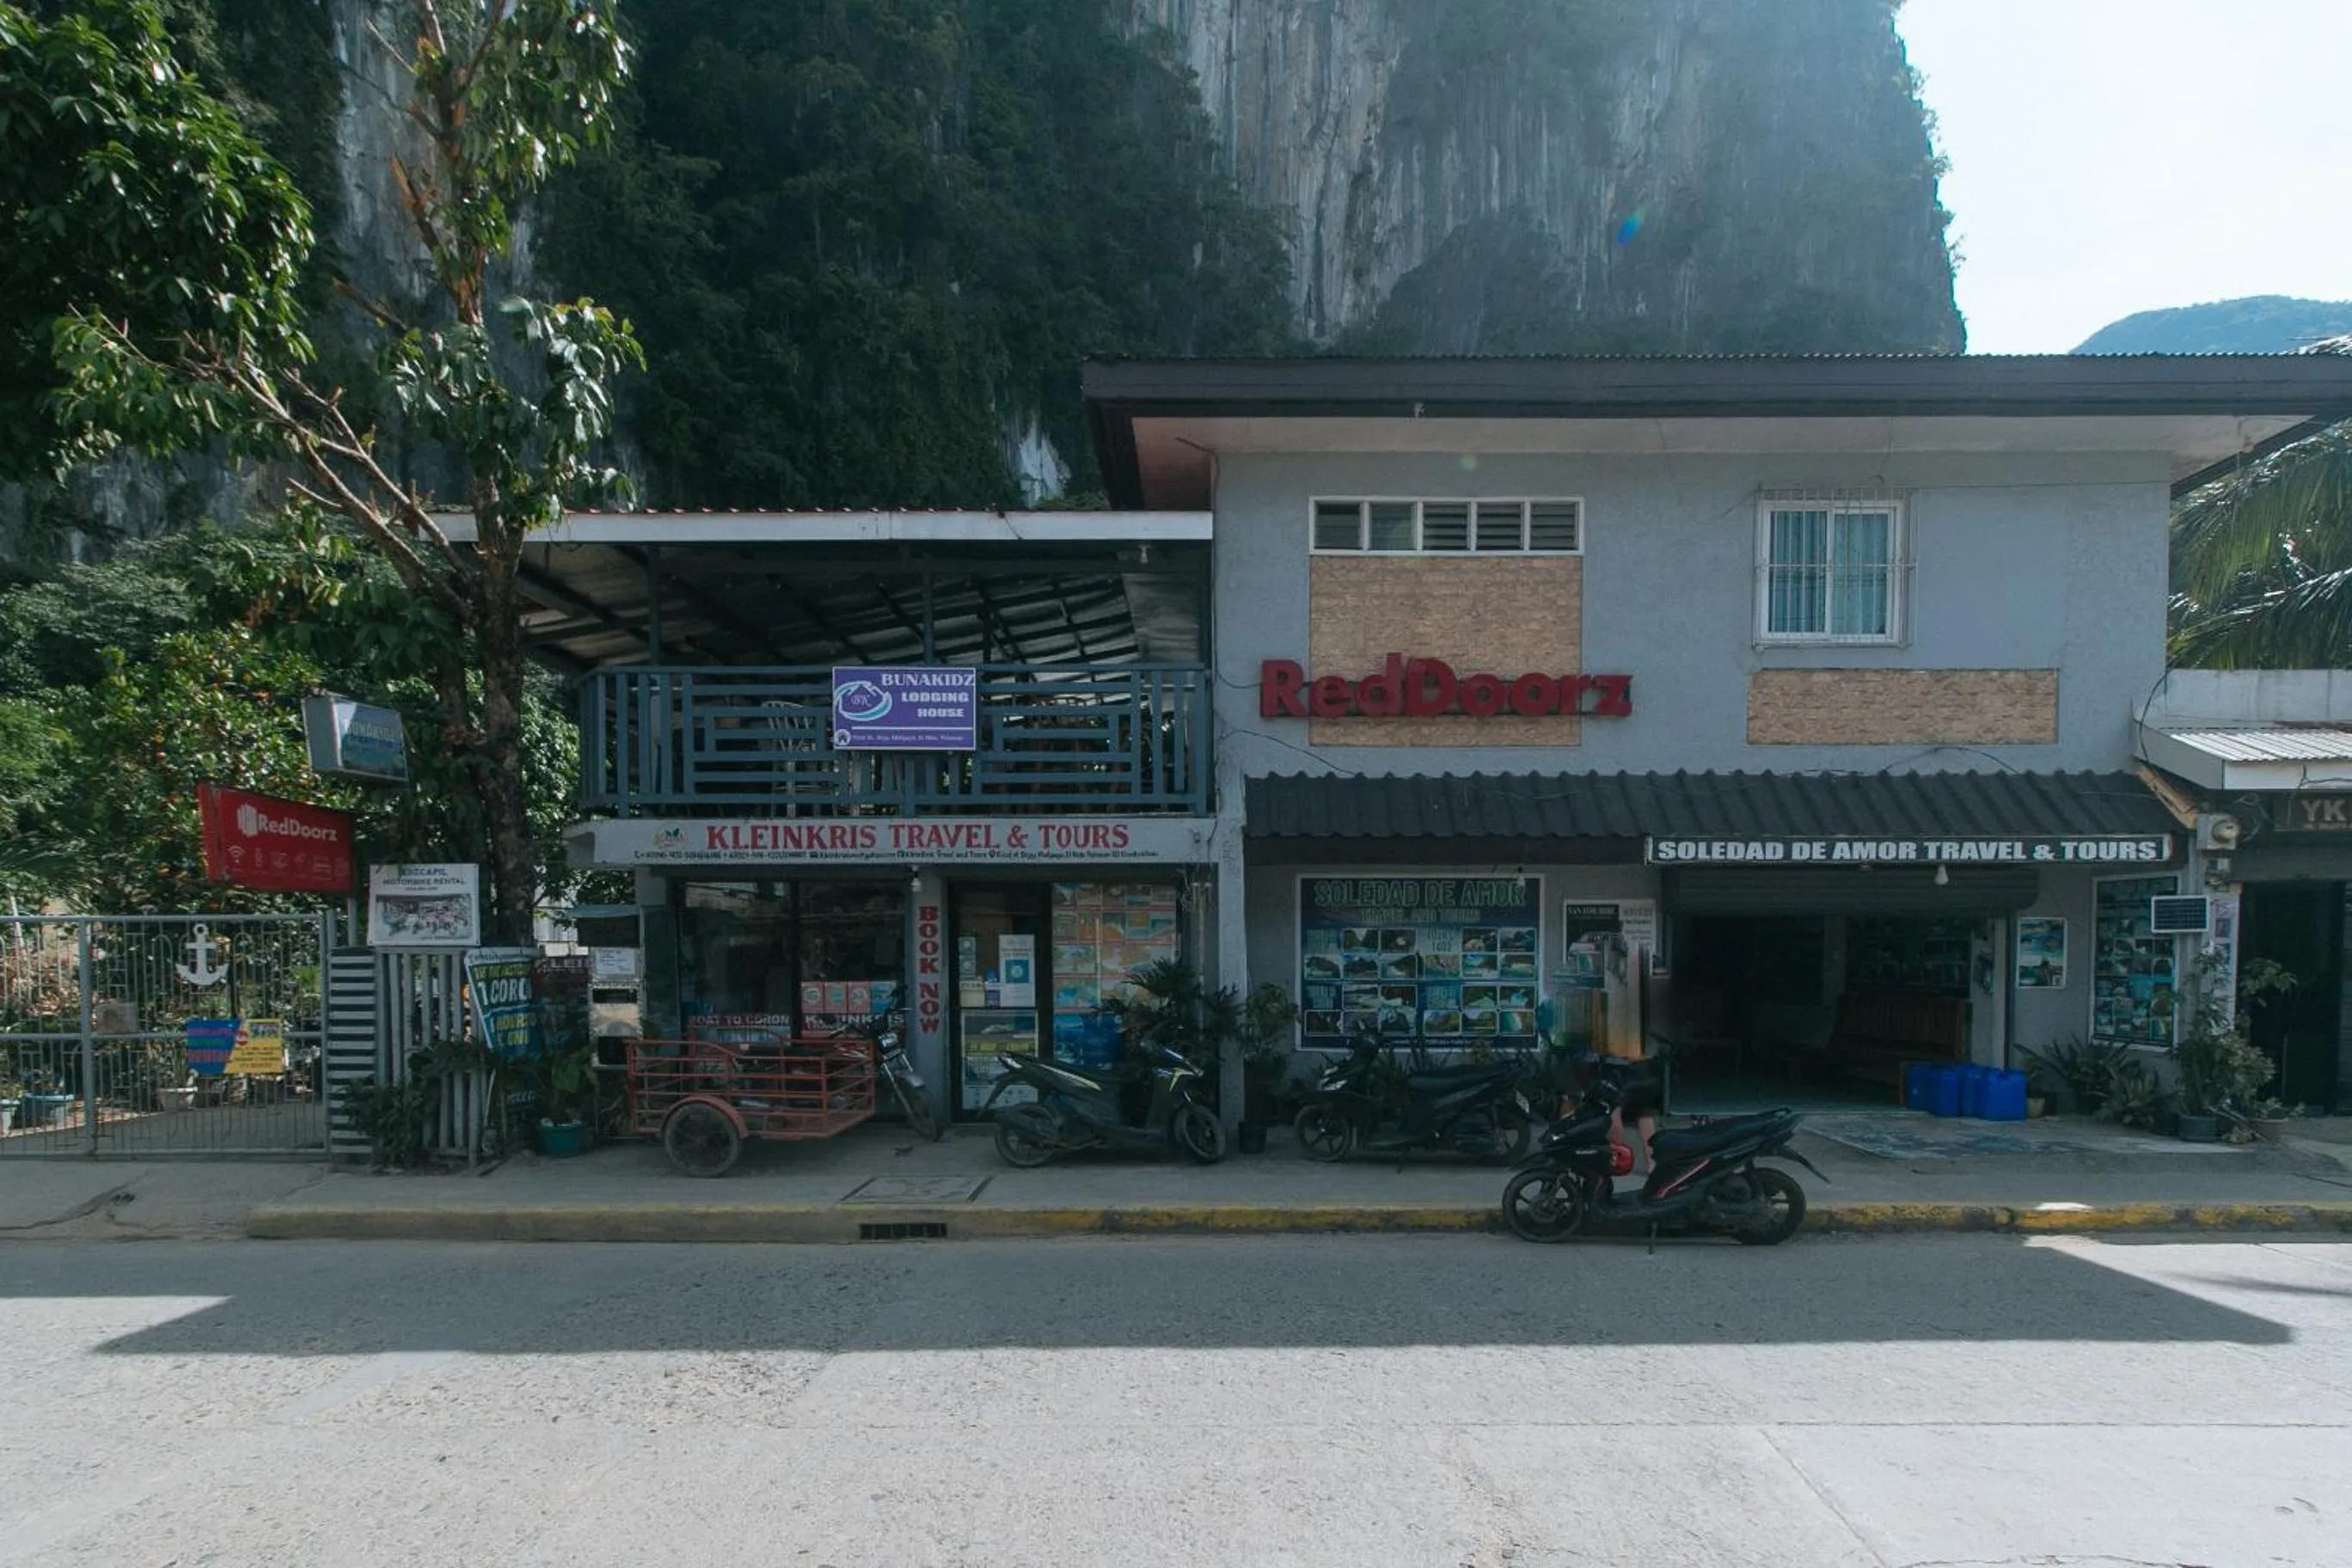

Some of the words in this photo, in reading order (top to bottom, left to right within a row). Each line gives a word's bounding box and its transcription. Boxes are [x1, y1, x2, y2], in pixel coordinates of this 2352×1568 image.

[881, 673, 975, 686] BUNAKIDZ
[1260, 652, 1632, 718] RedDoorz
[901, 691, 969, 702] LODGING
[916, 707, 965, 718] HOUSE
[258, 813, 338, 842] RedDoorz
[707, 825, 877, 850] KLEINKRIS
[889, 824, 1000, 849] TRAVEL
[1007, 825, 1029, 848] &
[1038, 824, 1130, 848] TOURS
[1658, 842, 1784, 860] SOLEDAD
[1792, 842, 1826, 860] DE
[1832, 842, 1917, 860] AMOR
[1924, 842, 2027, 860] TRAVEL
[2033, 844, 2055, 860] &
[2061, 842, 2156, 860] TOURS
[1314, 880, 1418, 907] SOLEDAD
[1425, 880, 1456, 907] DE
[1461, 880, 1526, 907] AMOR
[919, 906, 940, 974] BOOK
[725, 1014, 742, 1025] TO
[746, 1014, 790, 1025] CORON
[919, 983, 940, 1034] NOW
